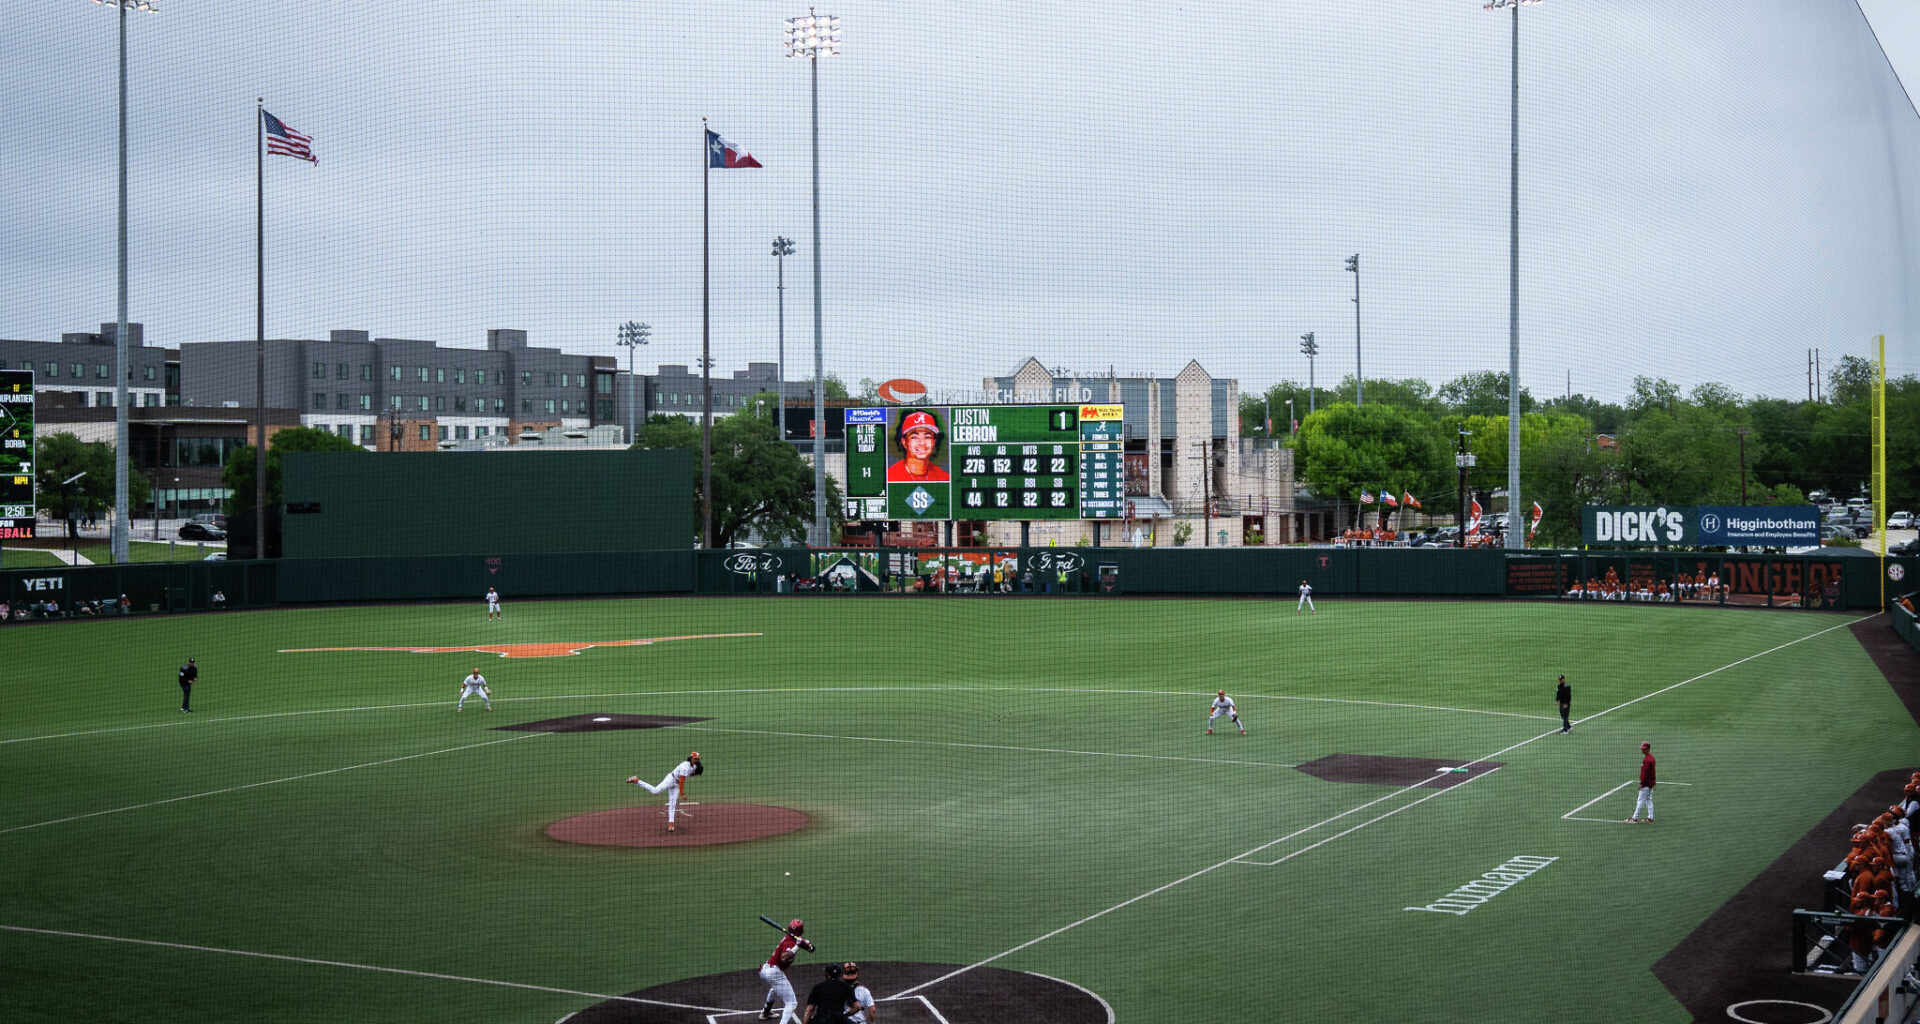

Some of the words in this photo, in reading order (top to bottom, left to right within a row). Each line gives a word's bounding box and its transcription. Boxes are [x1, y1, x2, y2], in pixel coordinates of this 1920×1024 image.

[1055, 387, 1092, 403] FIELD
[953, 409, 990, 425] JUSTIN
[1059, 411, 1066, 430] 1
[857, 425, 864, 434] AT
[865, 425, 875, 434] THE
[953, 426, 997, 442] LEBRON
[5, 440, 26, 448] BORBA
[857, 434, 875, 444] PLATE
[858, 444, 875, 452] TODAY
[967, 446, 981, 455] AVG
[997, 446, 1007, 455] AB
[1022, 445, 1038, 455] HITS
[1053, 445, 1063, 455] BB
[20, 462, 30, 472] T
[963, 458, 985, 473] .276
[993, 458, 1011, 473] 152
[1023, 458, 1037, 473] 42
[1051, 458, 1065, 473] 22
[14, 476, 28, 485] MPH
[971, 478, 977, 488] R
[997, 478, 1007, 488] HR
[1024, 478, 1036, 488] RBI
[912, 491, 928, 509] SS
[967, 492, 982, 507] 44
[996, 492, 1008, 507] 12
[1023, 492, 1037, 507] 32
[1051, 492, 1065, 507] 32
[5, 506, 26, 517] 12:50
[1596, 507, 1683, 542] DICK'S
[1727, 518, 1816, 531] Higginbotham
[23, 577, 63, 591] YETI
